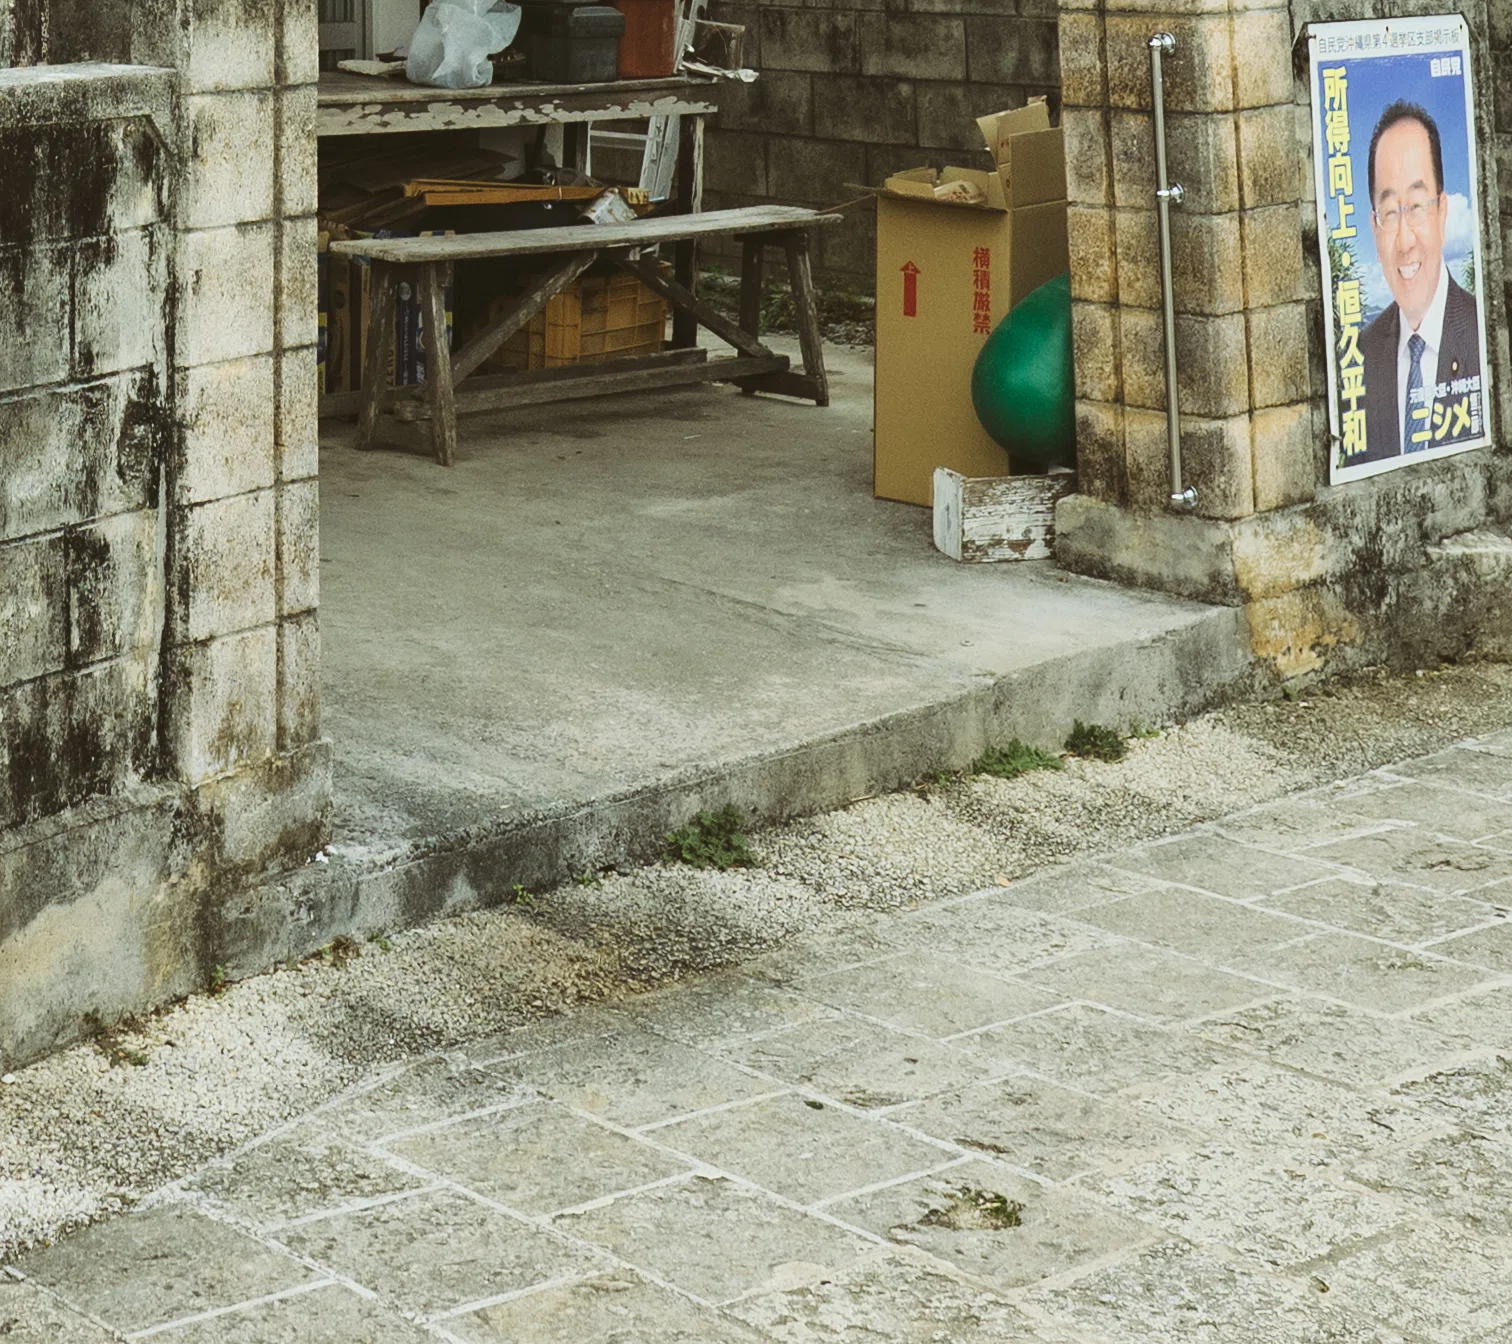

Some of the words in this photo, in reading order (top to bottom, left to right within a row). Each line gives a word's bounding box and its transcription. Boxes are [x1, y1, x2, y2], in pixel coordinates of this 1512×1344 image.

[972, 247, 991, 335] 横積厳禁
[1322, 67, 1368, 458] 所得向上・恒久平和
[1411, 396, 1471, 443] ニシメ
